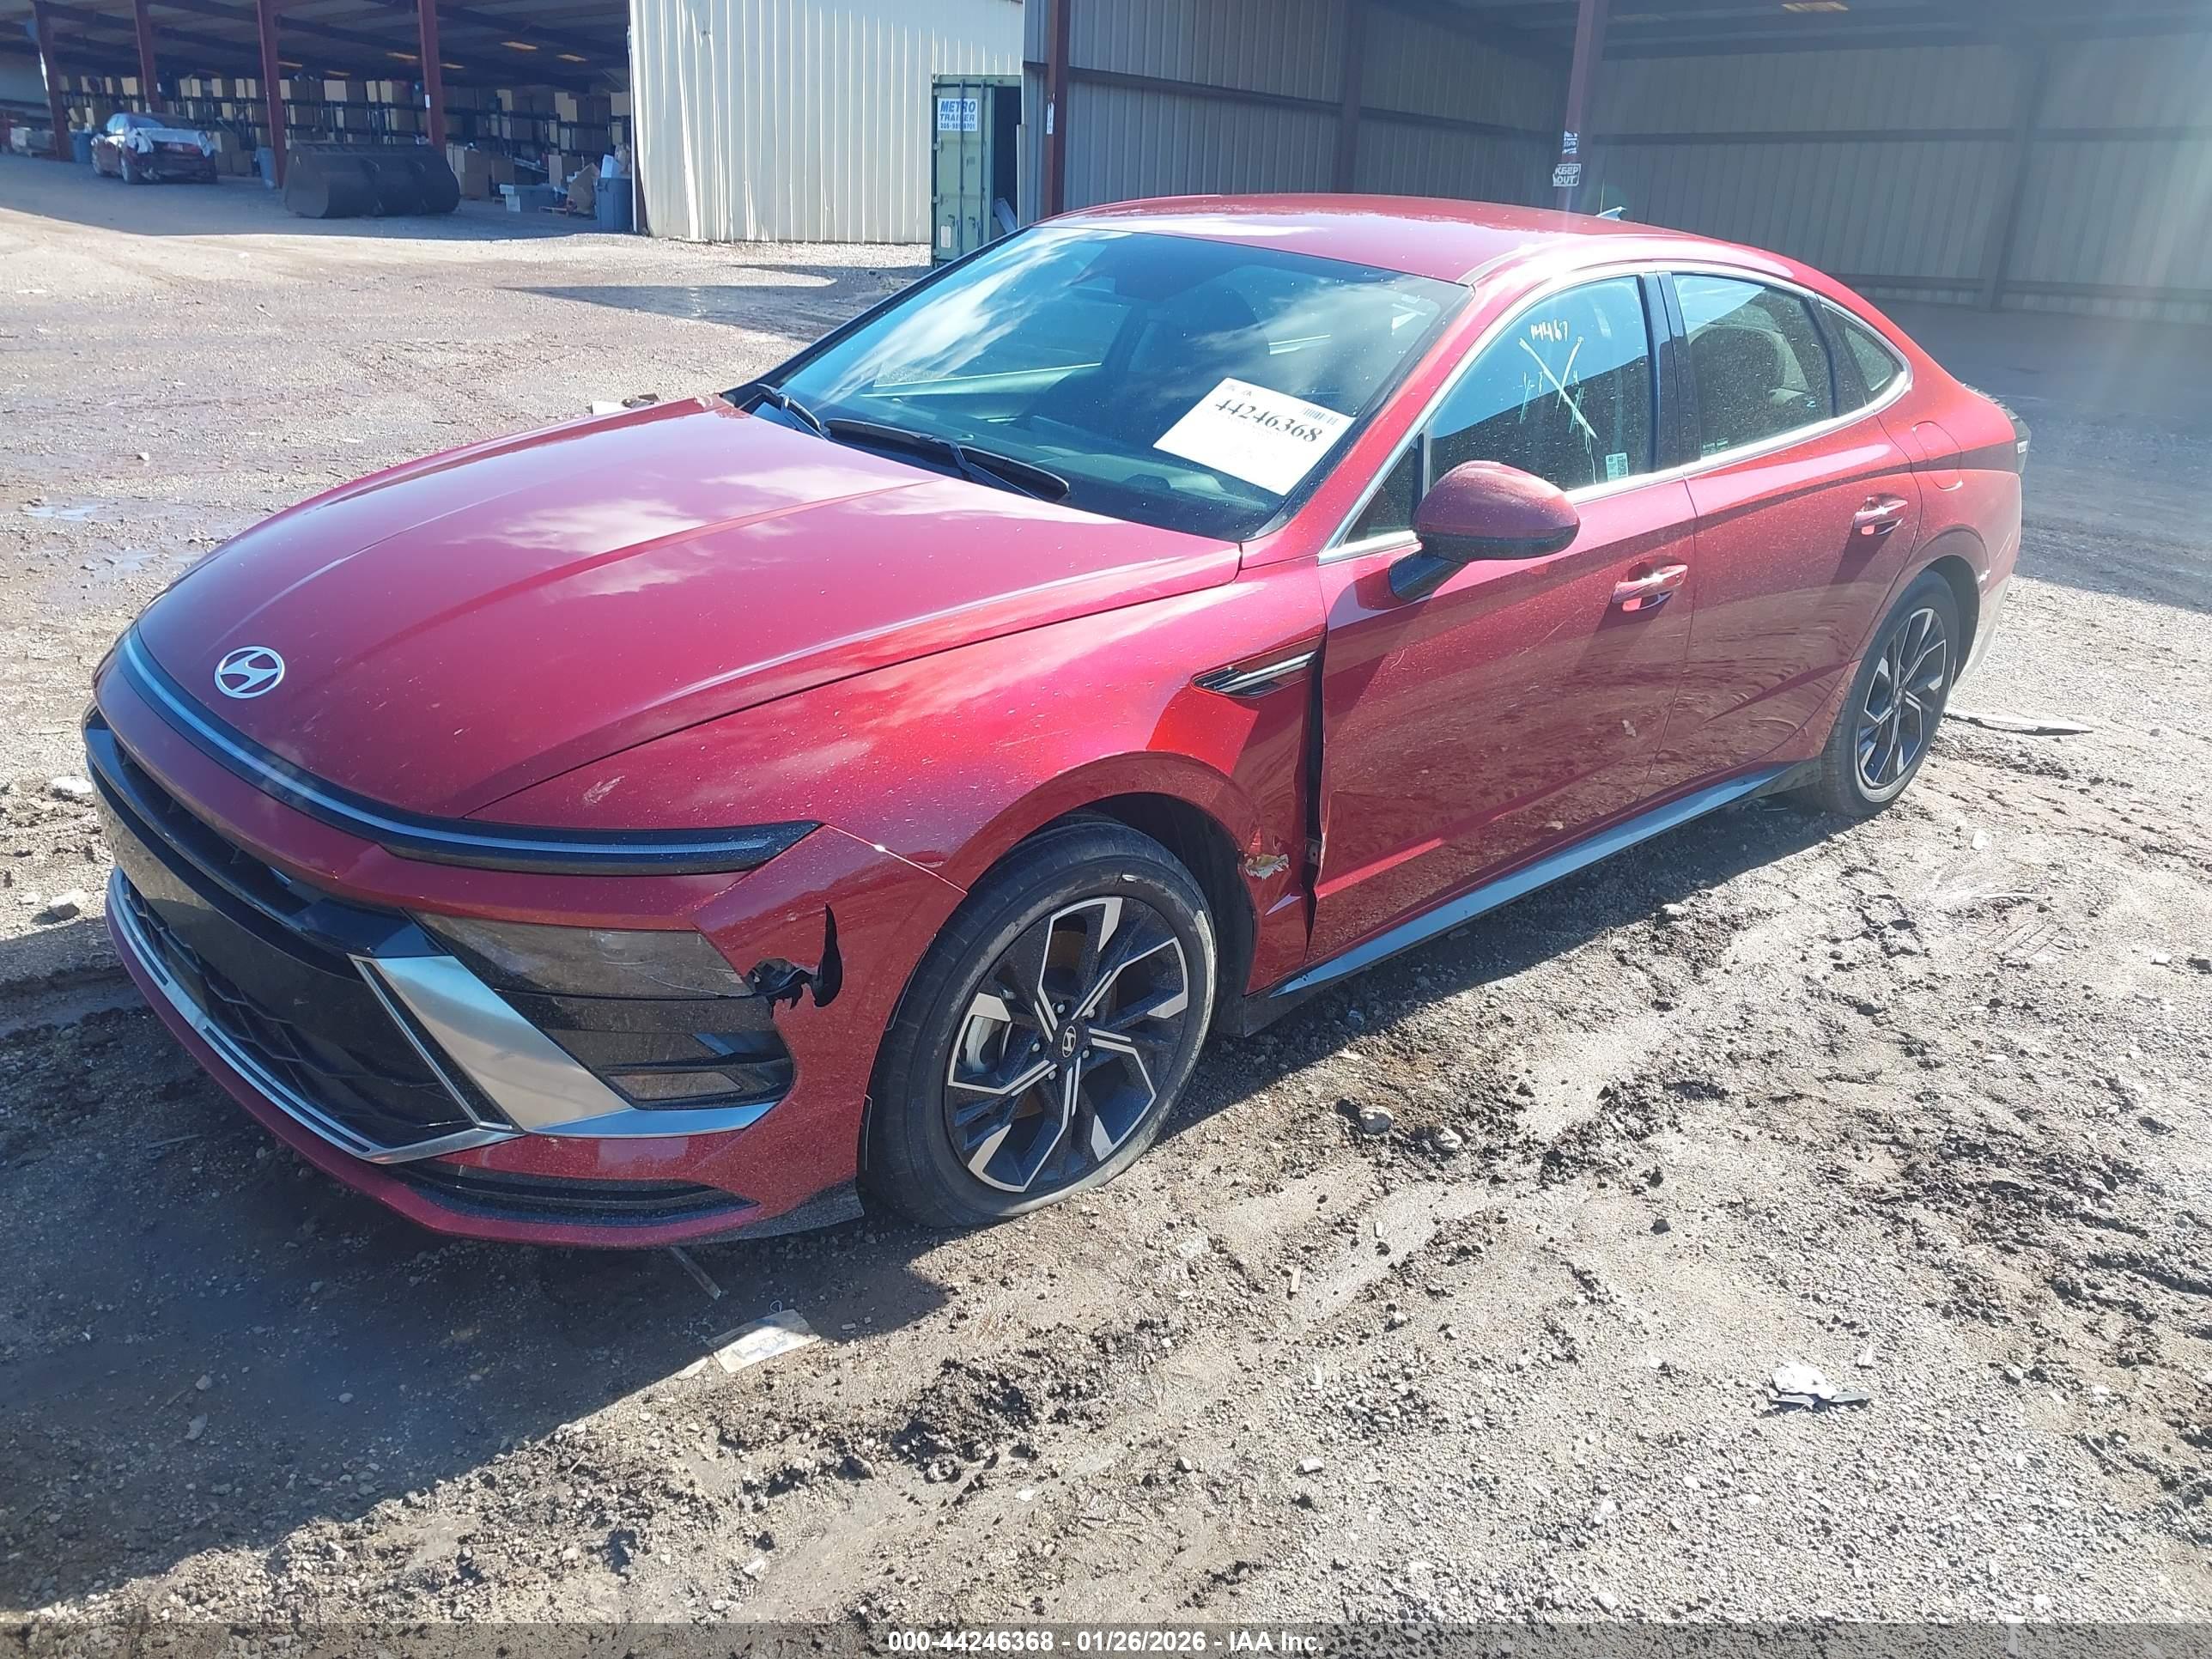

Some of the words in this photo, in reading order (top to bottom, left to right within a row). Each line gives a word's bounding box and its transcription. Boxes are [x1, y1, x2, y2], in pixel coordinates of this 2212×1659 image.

[940, 100, 976, 112] METRO
[1555, 167, 1579, 175] KEEP
[1557, 175, 1577, 184] OUT
[1215, 399, 1323, 442] 44246368
